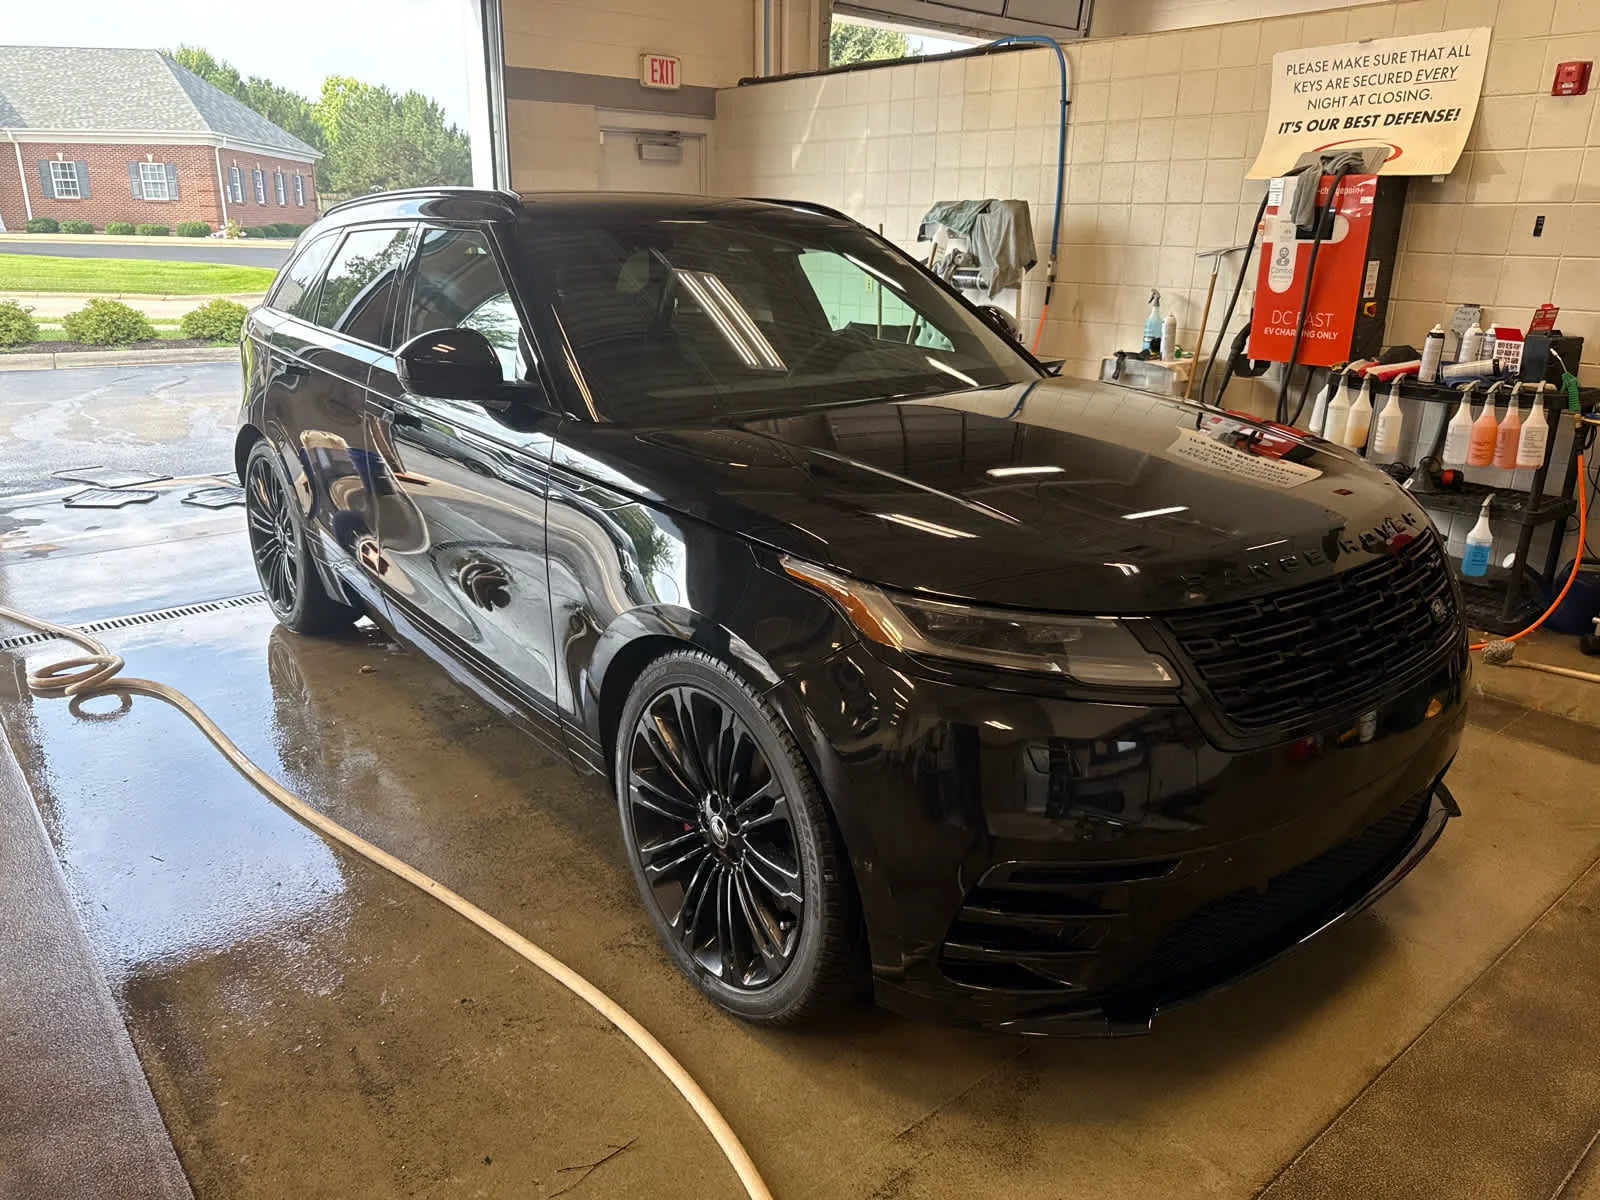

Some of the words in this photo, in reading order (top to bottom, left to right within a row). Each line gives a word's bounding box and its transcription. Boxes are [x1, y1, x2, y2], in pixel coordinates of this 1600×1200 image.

[650, 57, 676, 85] EXIT
[1286, 60, 1329, 76] PLEASE
[1332, 55, 1370, 71] MAKE
[1373, 51, 1408, 67] SURE
[1411, 46, 1446, 63] THAT
[1447, 44, 1471, 59] ALL
[1293, 80, 1323, 94] KEYS
[1325, 76, 1351, 91] ARE
[1353, 70, 1413, 88] SECURED
[1416, 65, 1459, 82] EVERY
[1307, 95, 1349, 111] NIGHT
[1349, 94, 1366, 107] AT
[1367, 88, 1433, 105] CLOSING.
[1278, 120, 1303, 135] IT'S
[1306, 117, 1340, 132] OUR
[1343, 114, 1382, 129] BEST
[1383, 107, 1462, 127] DEFENSE!
[1271, 310, 1293, 325] DC
[1264, 326, 1275, 335] EV
[1275, 327, 1316, 338] CHARING
[1316, 330, 1339, 340] ONLY
